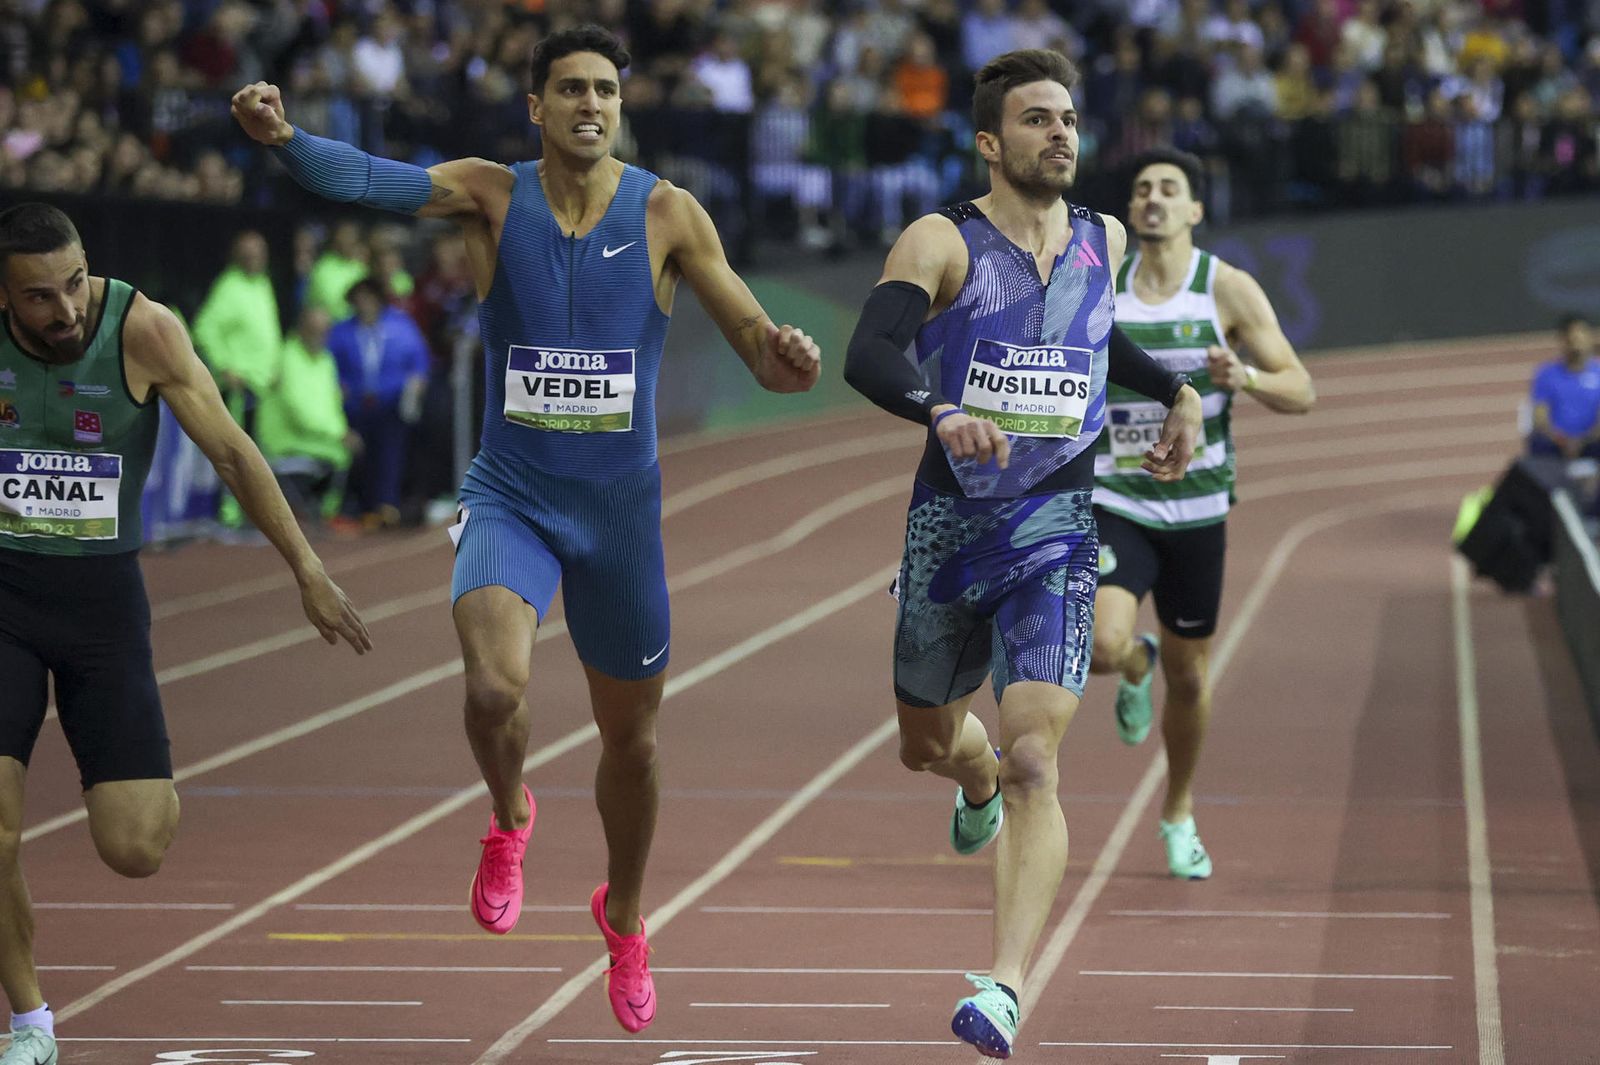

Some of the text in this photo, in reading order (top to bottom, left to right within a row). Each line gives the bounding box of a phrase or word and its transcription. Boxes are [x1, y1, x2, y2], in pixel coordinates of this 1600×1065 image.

[535, 351, 608, 370] Joma
[1001, 348, 1068, 367] Joma
[522, 376, 618, 399] VEDEL
[968, 368, 1088, 399] HUSILLOS
[556, 404, 598, 413] MADRID
[1014, 403, 1056, 413] MADRID
[573, 420, 591, 431] 23
[972, 412, 1049, 432] DRID 23
[16, 453, 92, 472] Joma
[3, 475, 104, 502] CAÑAL
[38, 507, 81, 517] MADRID
[55, 523, 75, 536] 23
